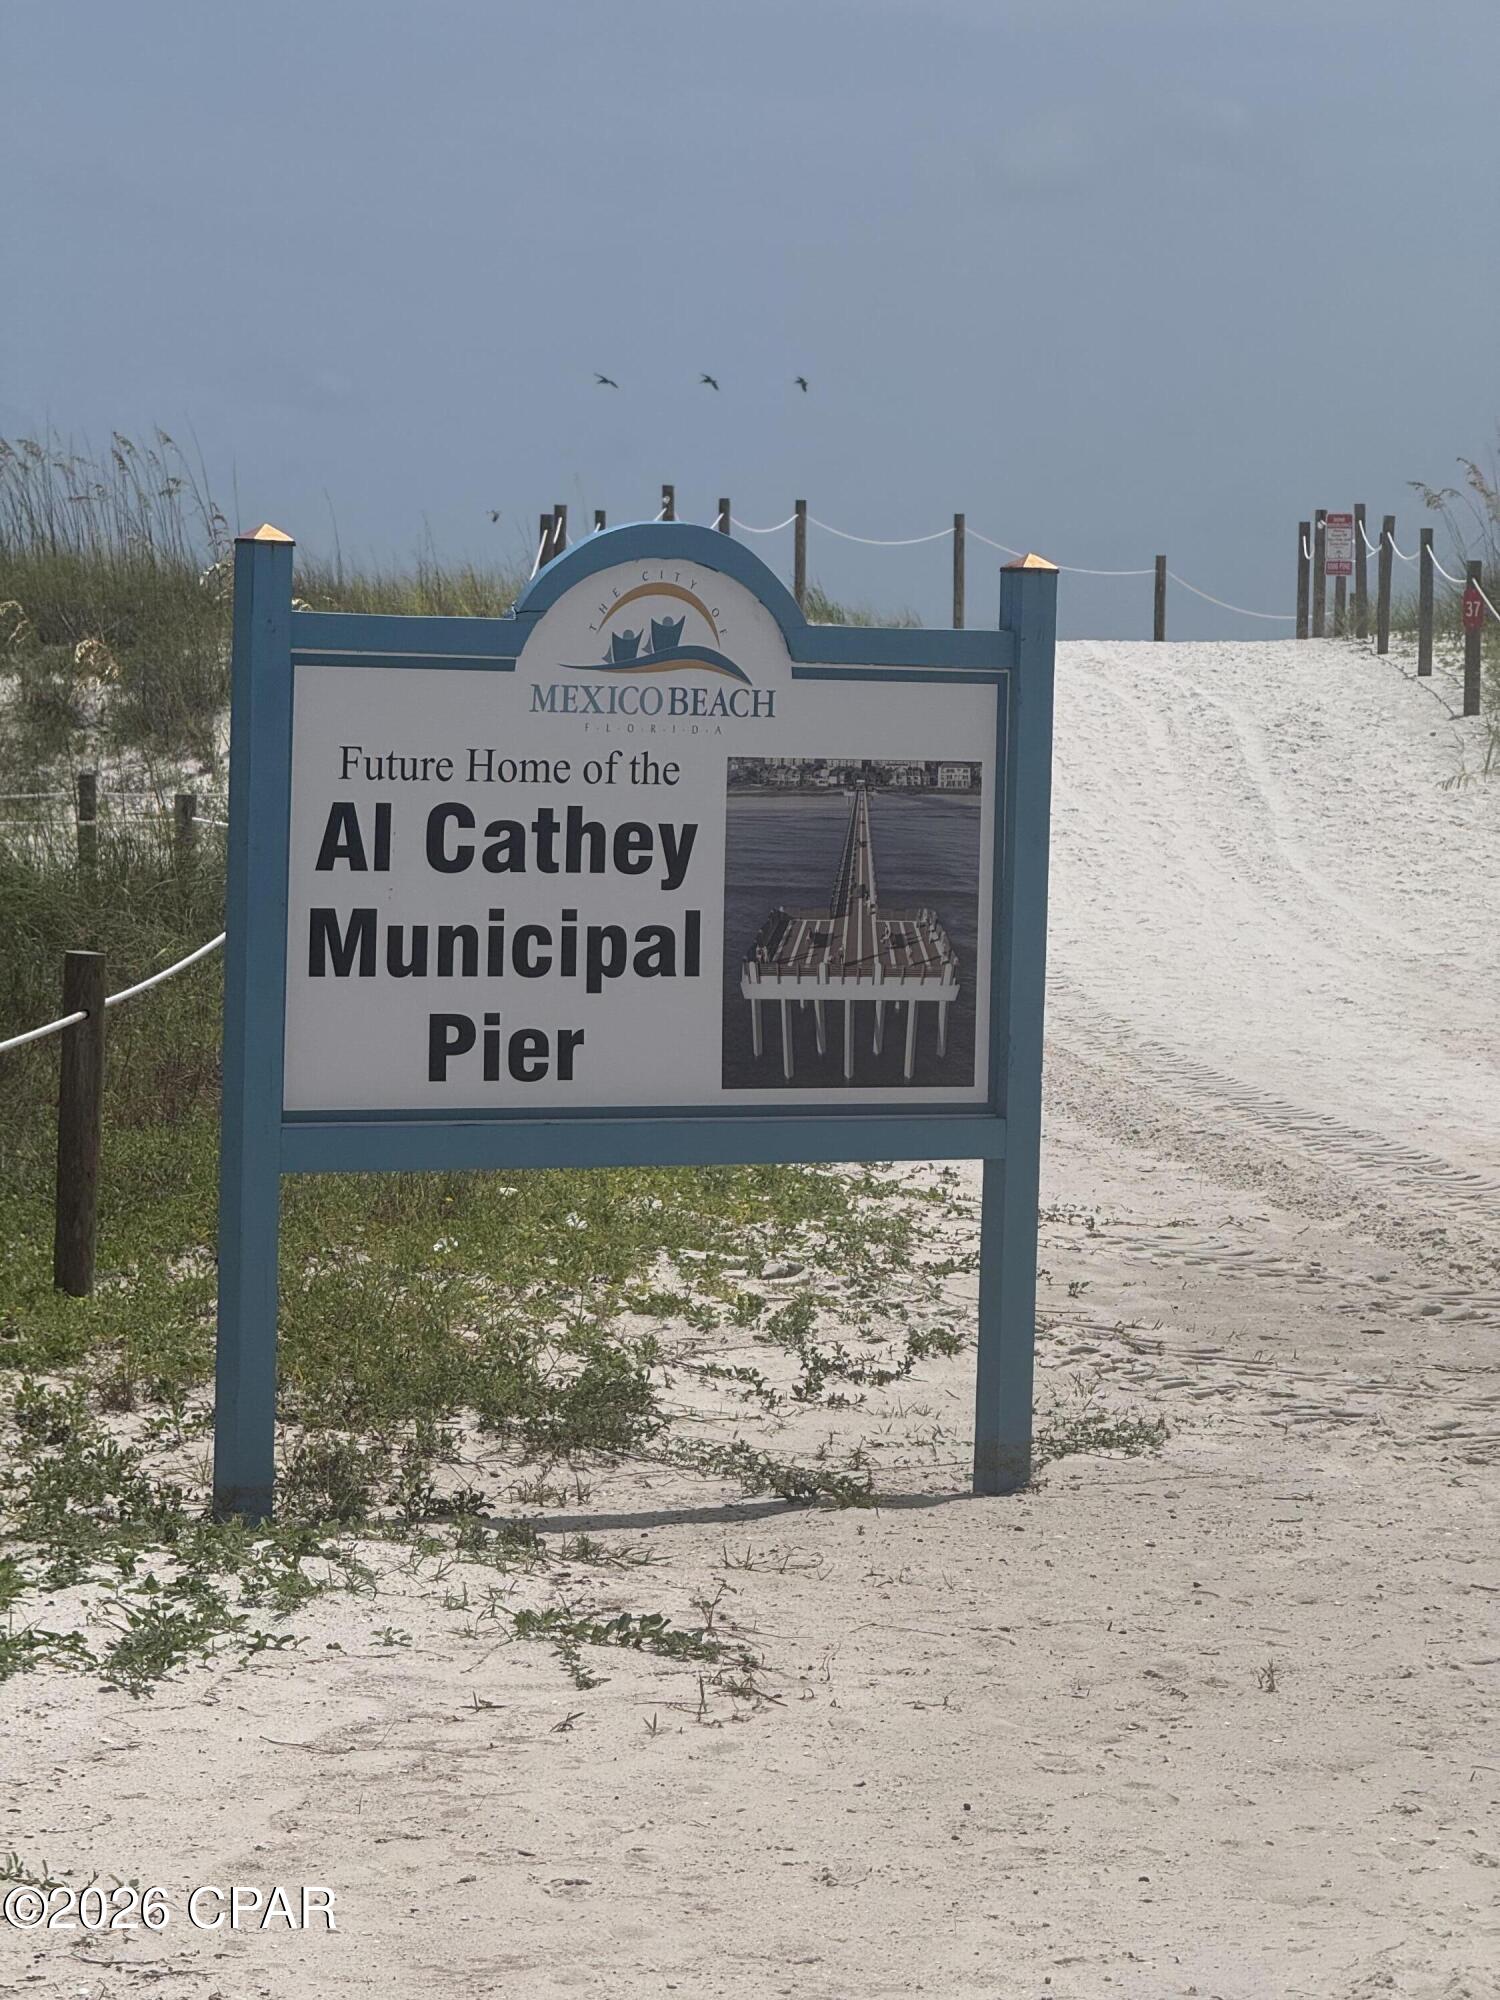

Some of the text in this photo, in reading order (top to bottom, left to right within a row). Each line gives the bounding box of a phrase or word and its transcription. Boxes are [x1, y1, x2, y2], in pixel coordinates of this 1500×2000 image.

[589, 570, 728, 637] THE CITY OF
[1465, 601, 1481, 617] 37
[529, 684, 776, 718] MEXICO BEACH
[338, 745, 681, 786] Future Home of the
[315, 801, 699, 891] Al Cathey
[308, 908, 701, 994] Municipal
[428, 1012, 585, 1082] Pier
